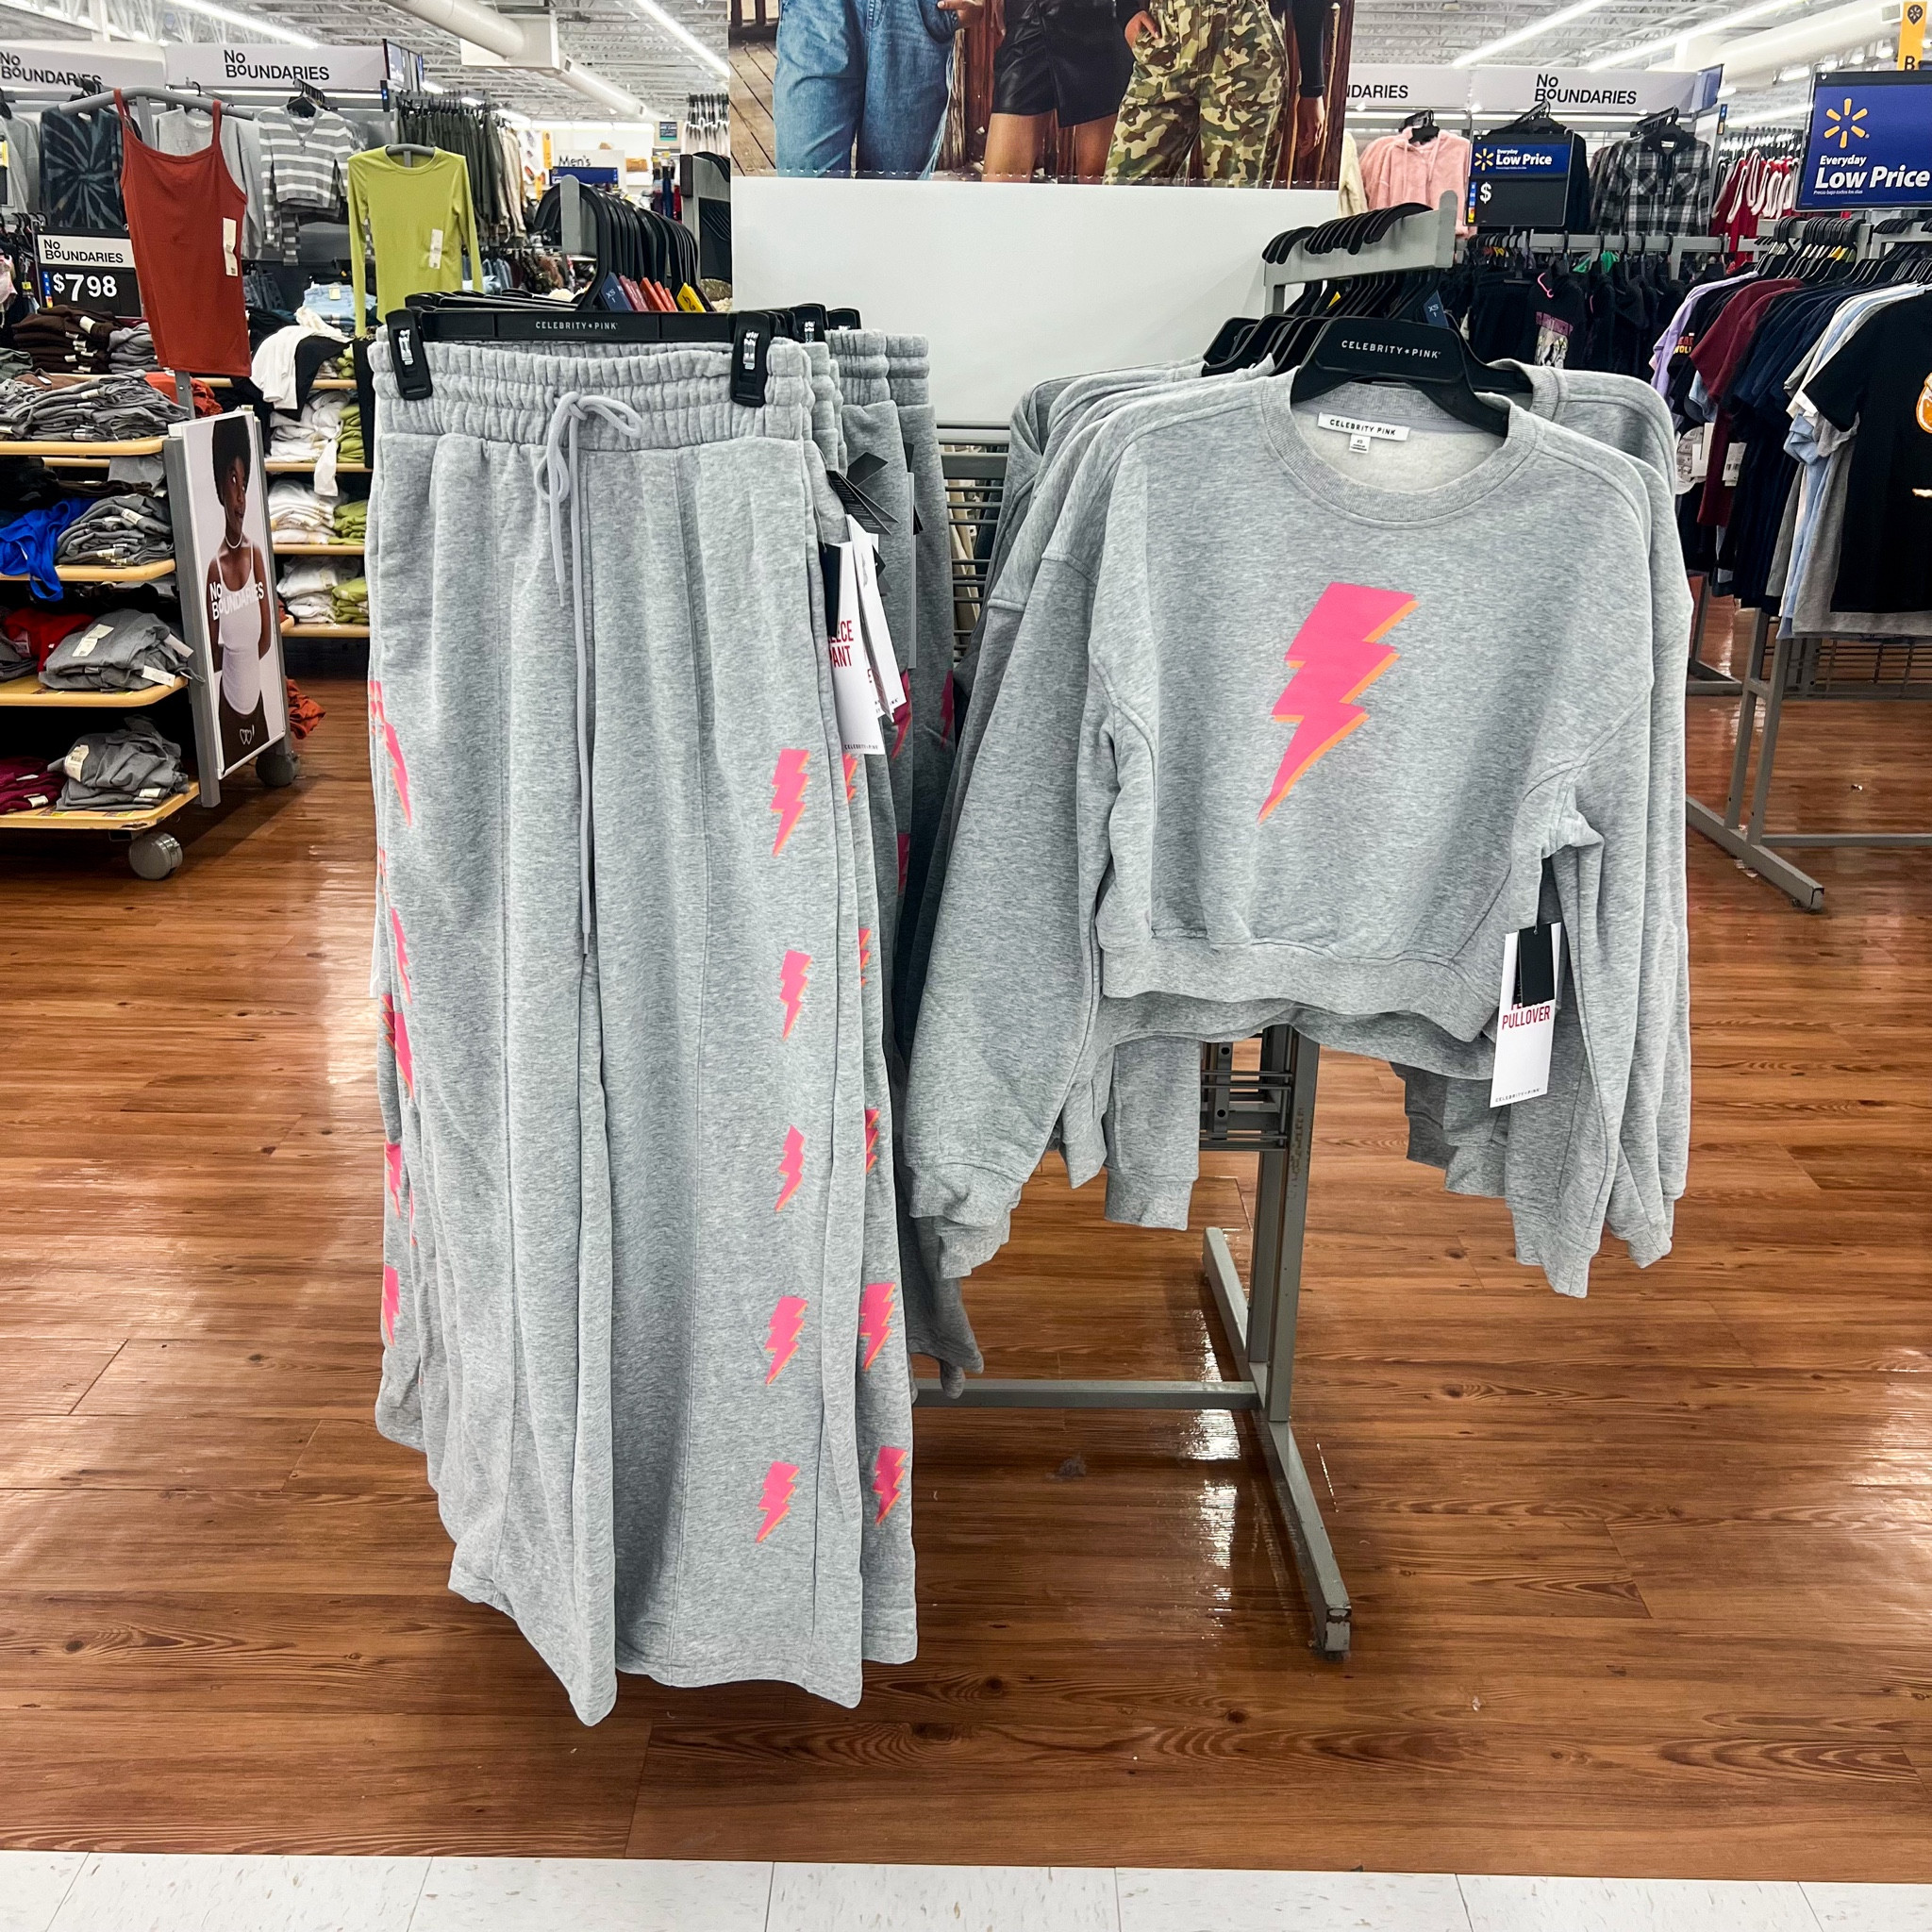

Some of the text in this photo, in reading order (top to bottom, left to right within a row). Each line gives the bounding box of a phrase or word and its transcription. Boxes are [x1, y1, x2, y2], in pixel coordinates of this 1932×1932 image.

[225, 64, 330, 80] BOUNDARIES
[1534, 88, 1638, 105] BOUNDARIES
[558, 155, 591, 167] Men's
[1495, 153, 1553, 165] Low Price
[1819, 154, 1868, 168] Everyday
[1814, 164, 1931, 189] Low Price
[1479, 181, 1492, 204] $
[44, 249, 124, 263] BOUNDARIES
[535, 321, 616, 330] CELEBRITY PINK
[1341, 340, 1439, 358] CELEBRITY PINK
[1329, 419, 1396, 436] CELEBRITY PINK
[830, 645, 852, 668] ANT
[1502, 1005, 1551, 1030] PULLOVER
